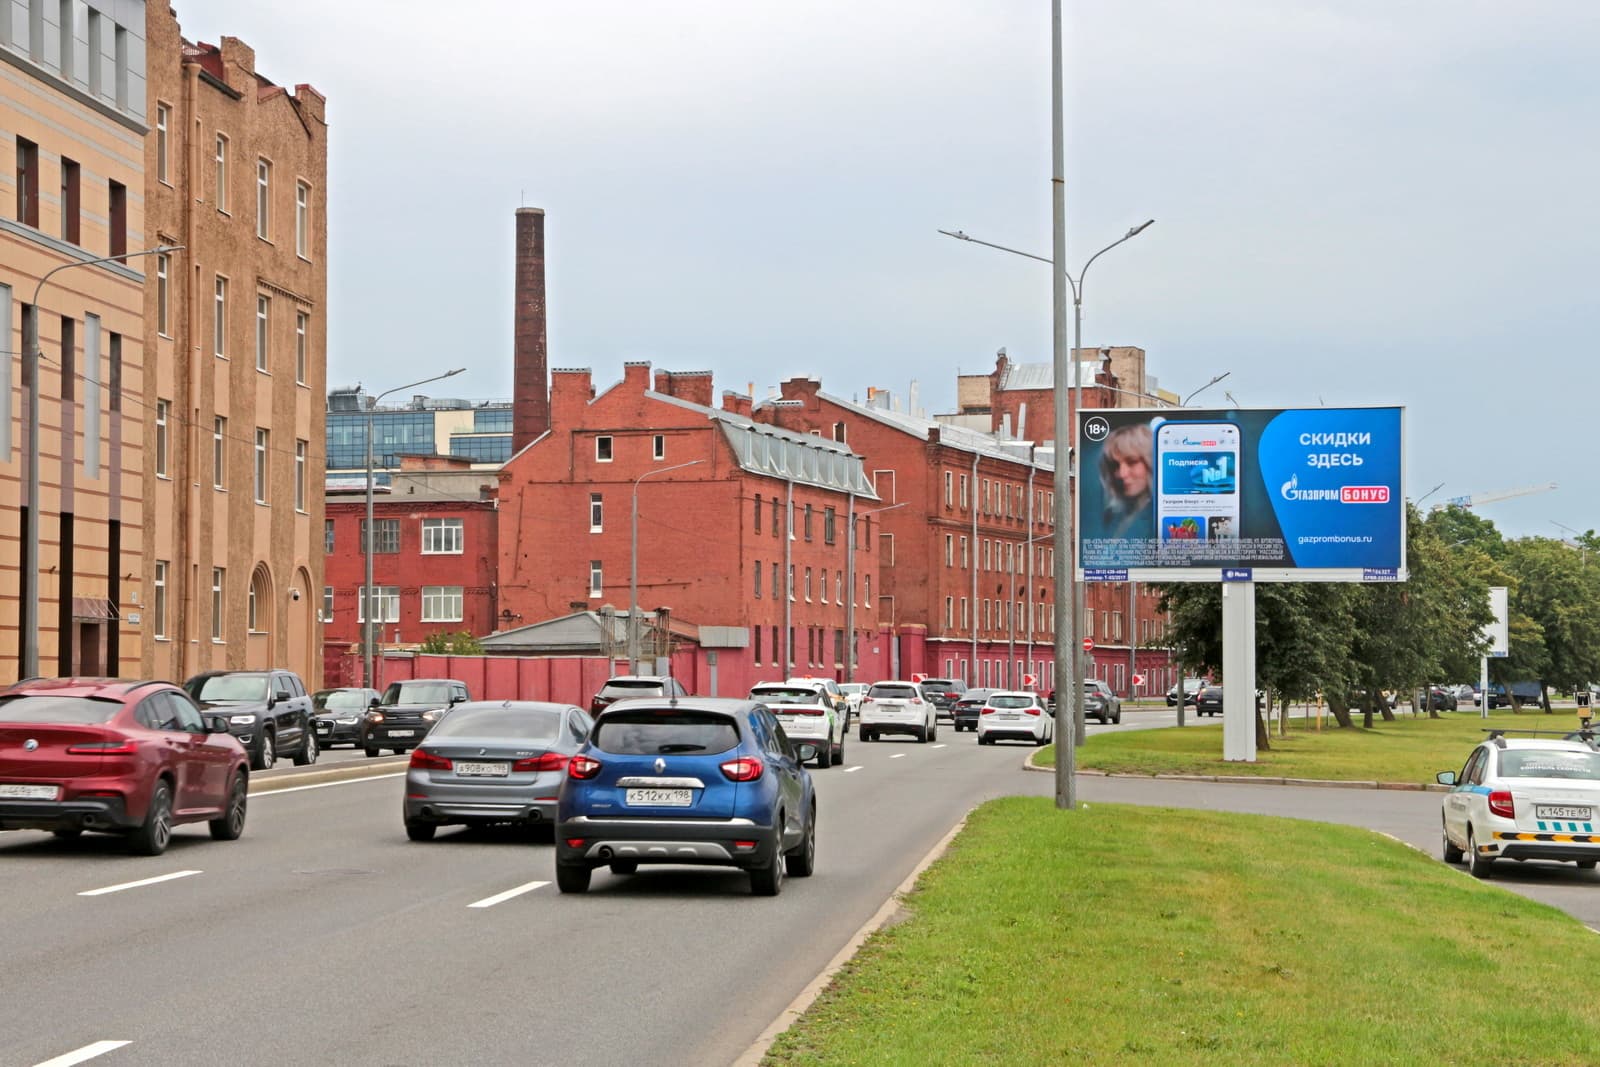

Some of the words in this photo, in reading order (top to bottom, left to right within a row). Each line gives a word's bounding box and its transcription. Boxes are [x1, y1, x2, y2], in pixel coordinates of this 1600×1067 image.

[1088, 424, 1107, 434] 18+
[1299, 432, 1371, 448] СКИДКИ
[1168, 458, 1208, 467] Подписка
[1307, 453, 1364, 469] ЗДЕСЬ
[1299, 489, 1339, 500] ГАЗПРОМ
[1343, 489, 1387, 501] БОНУС
[1298, 535, 1373, 545] gazprombonus.ru
